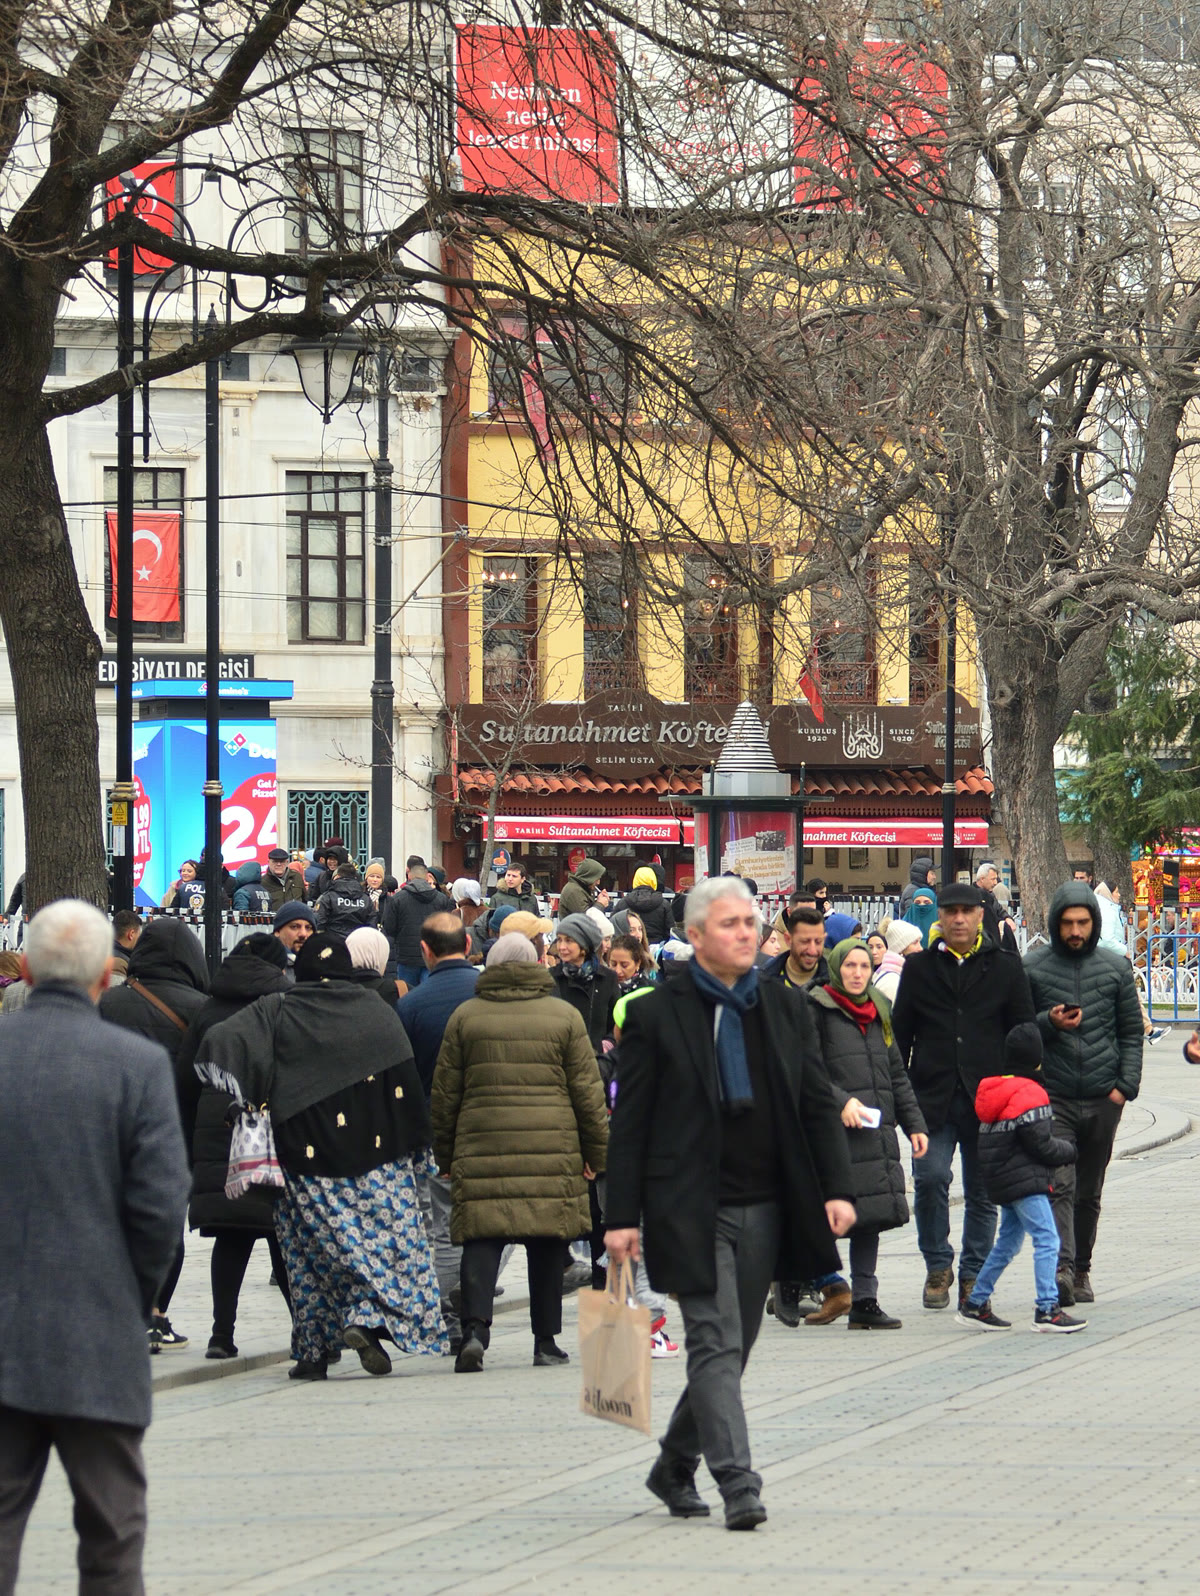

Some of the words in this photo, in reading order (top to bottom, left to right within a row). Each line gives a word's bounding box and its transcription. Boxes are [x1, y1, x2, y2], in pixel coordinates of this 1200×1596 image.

[186, 658, 249, 679] DEGİSİ
[797, 728, 837, 736] KURULUŞ
[889, 728, 915, 736] SINCE
[807, 735, 828, 743] 1920
[595, 756, 626, 764] SELİM
[515, 827, 545, 835] TARİHİ
[548, 825, 620, 837] Sultanahmet
[623, 826, 671, 839] Köftecisi
[850, 831, 896, 843] Köftecisi
